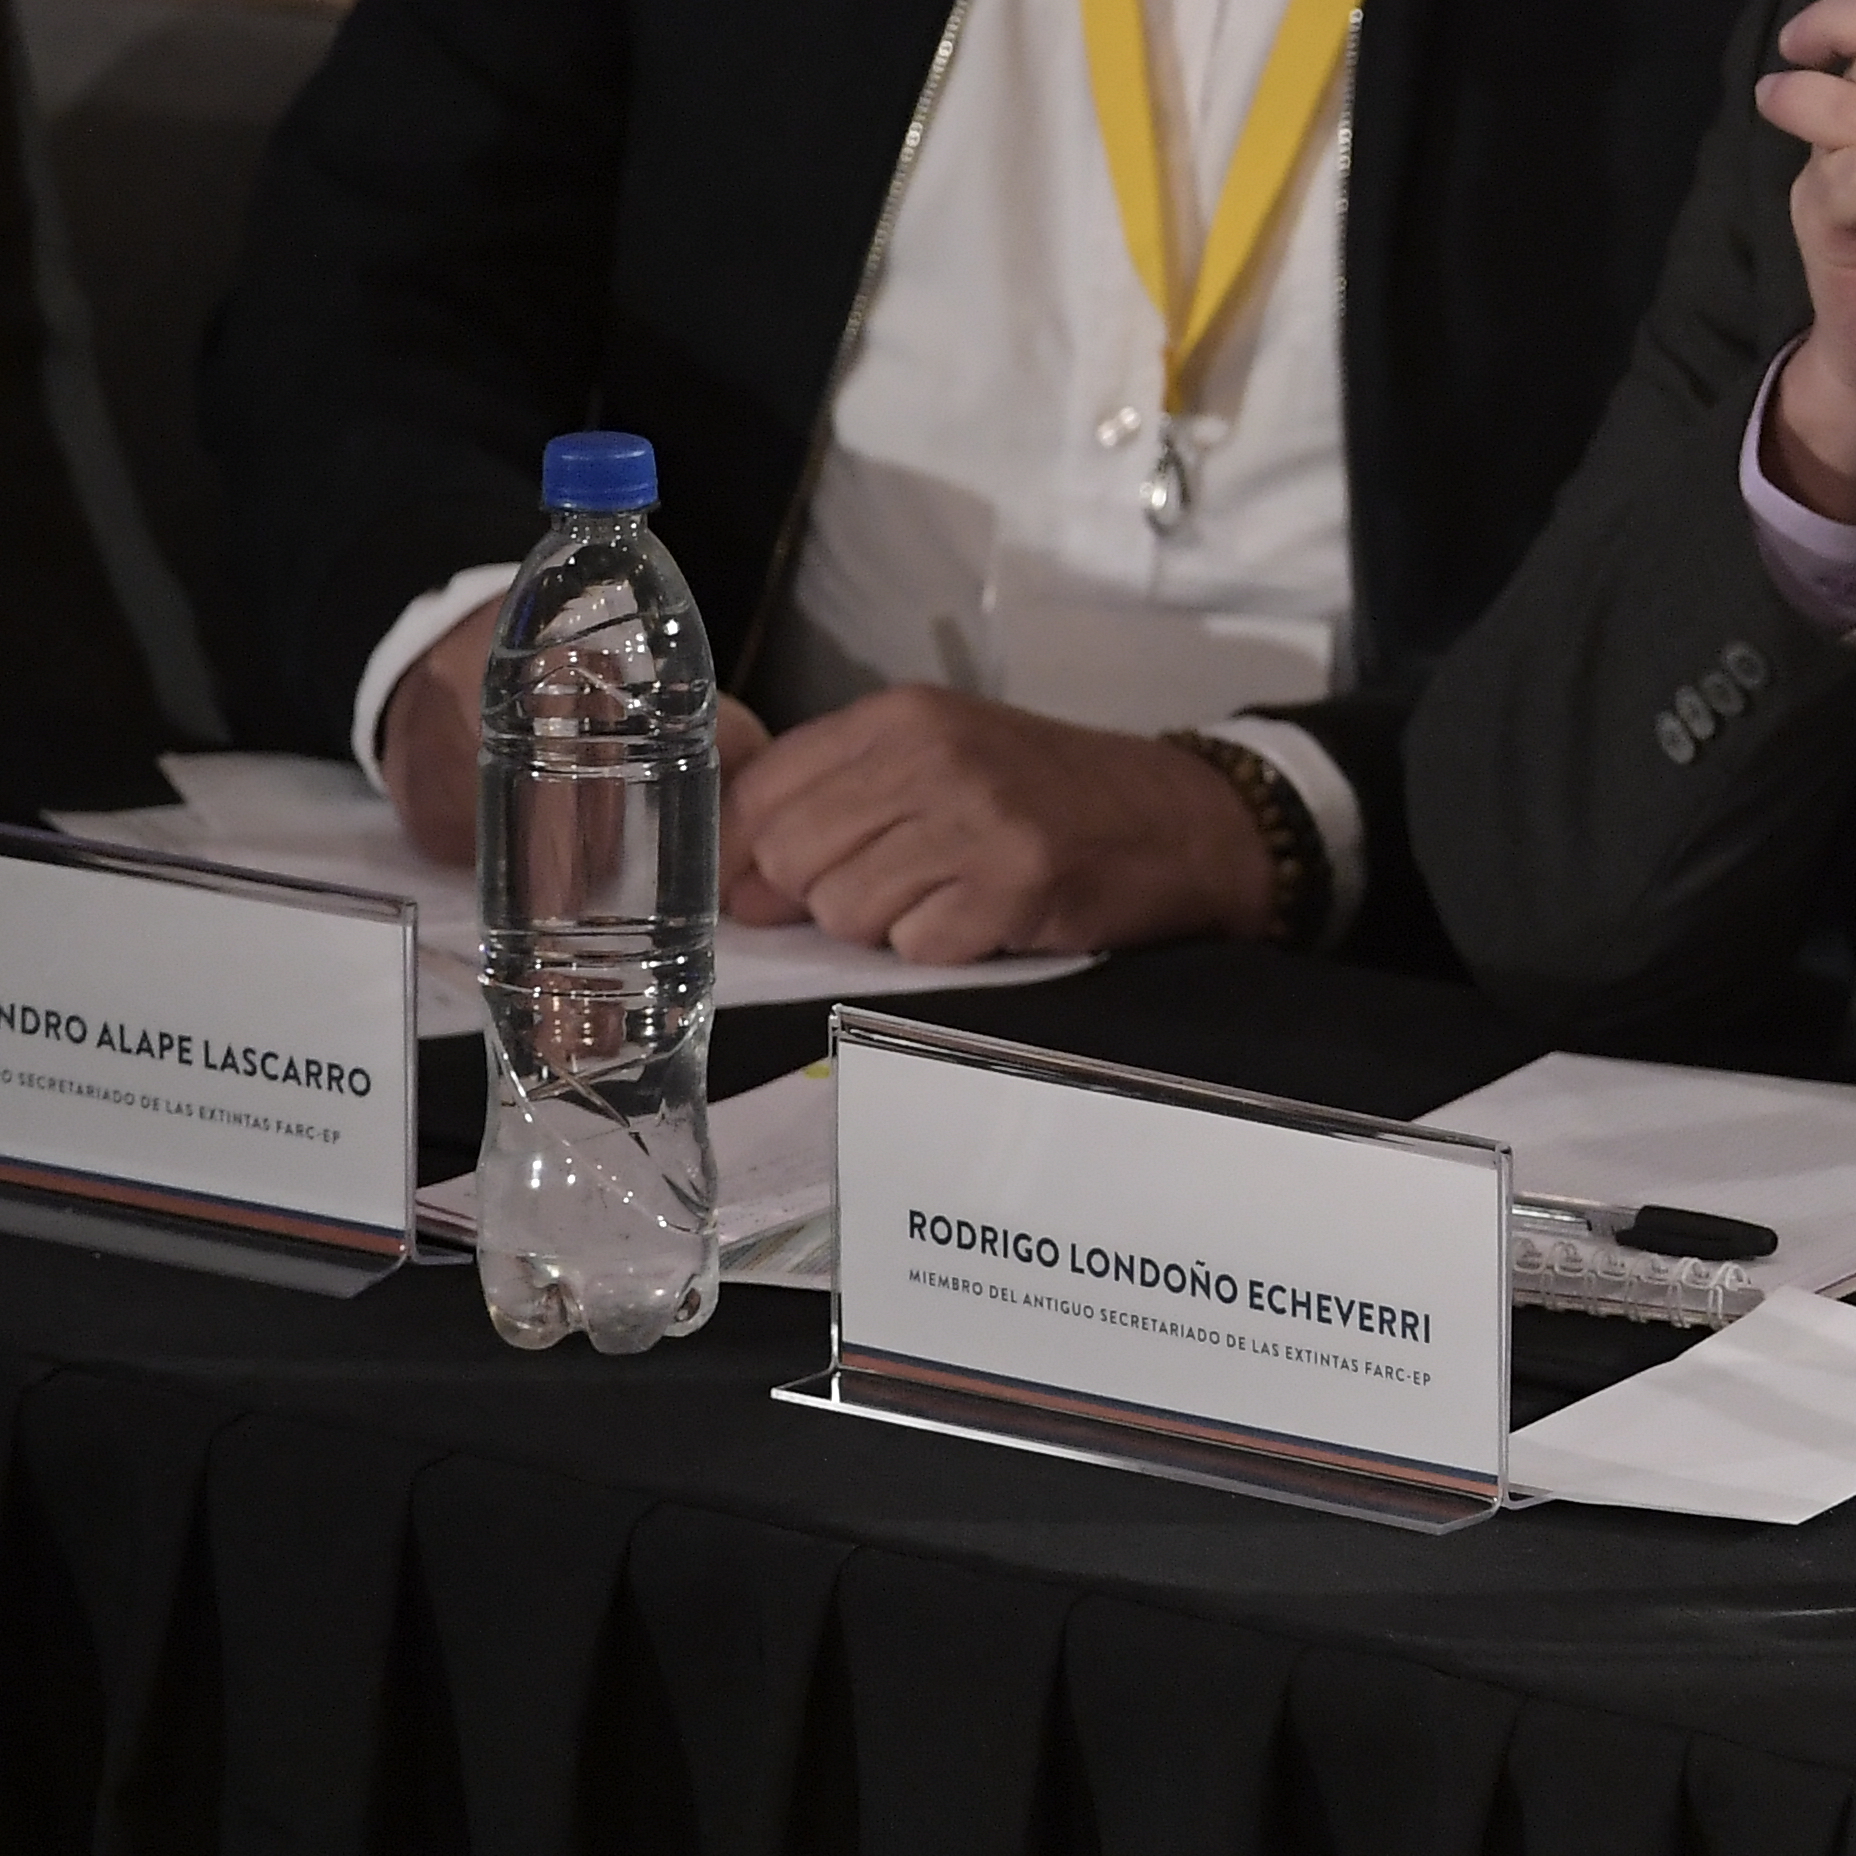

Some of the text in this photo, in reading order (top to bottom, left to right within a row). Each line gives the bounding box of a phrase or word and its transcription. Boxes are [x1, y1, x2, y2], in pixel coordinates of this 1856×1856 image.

[18, 1071, 136, 1106] SECRETARIADO
[165, 1100, 193, 1117] LAS
[96, 1022, 193, 1066] ALAPE
[204, 1040, 371, 1097] LASCARRO
[909, 1210, 1429, 1343] RODRIGO LONDOÑO ECHEVERRI
[909, 1269, 1431, 1385] MIEMBRO DEL ANTIGUO SECRETARIADO DE LAS EXTINTAS FARC-EP
